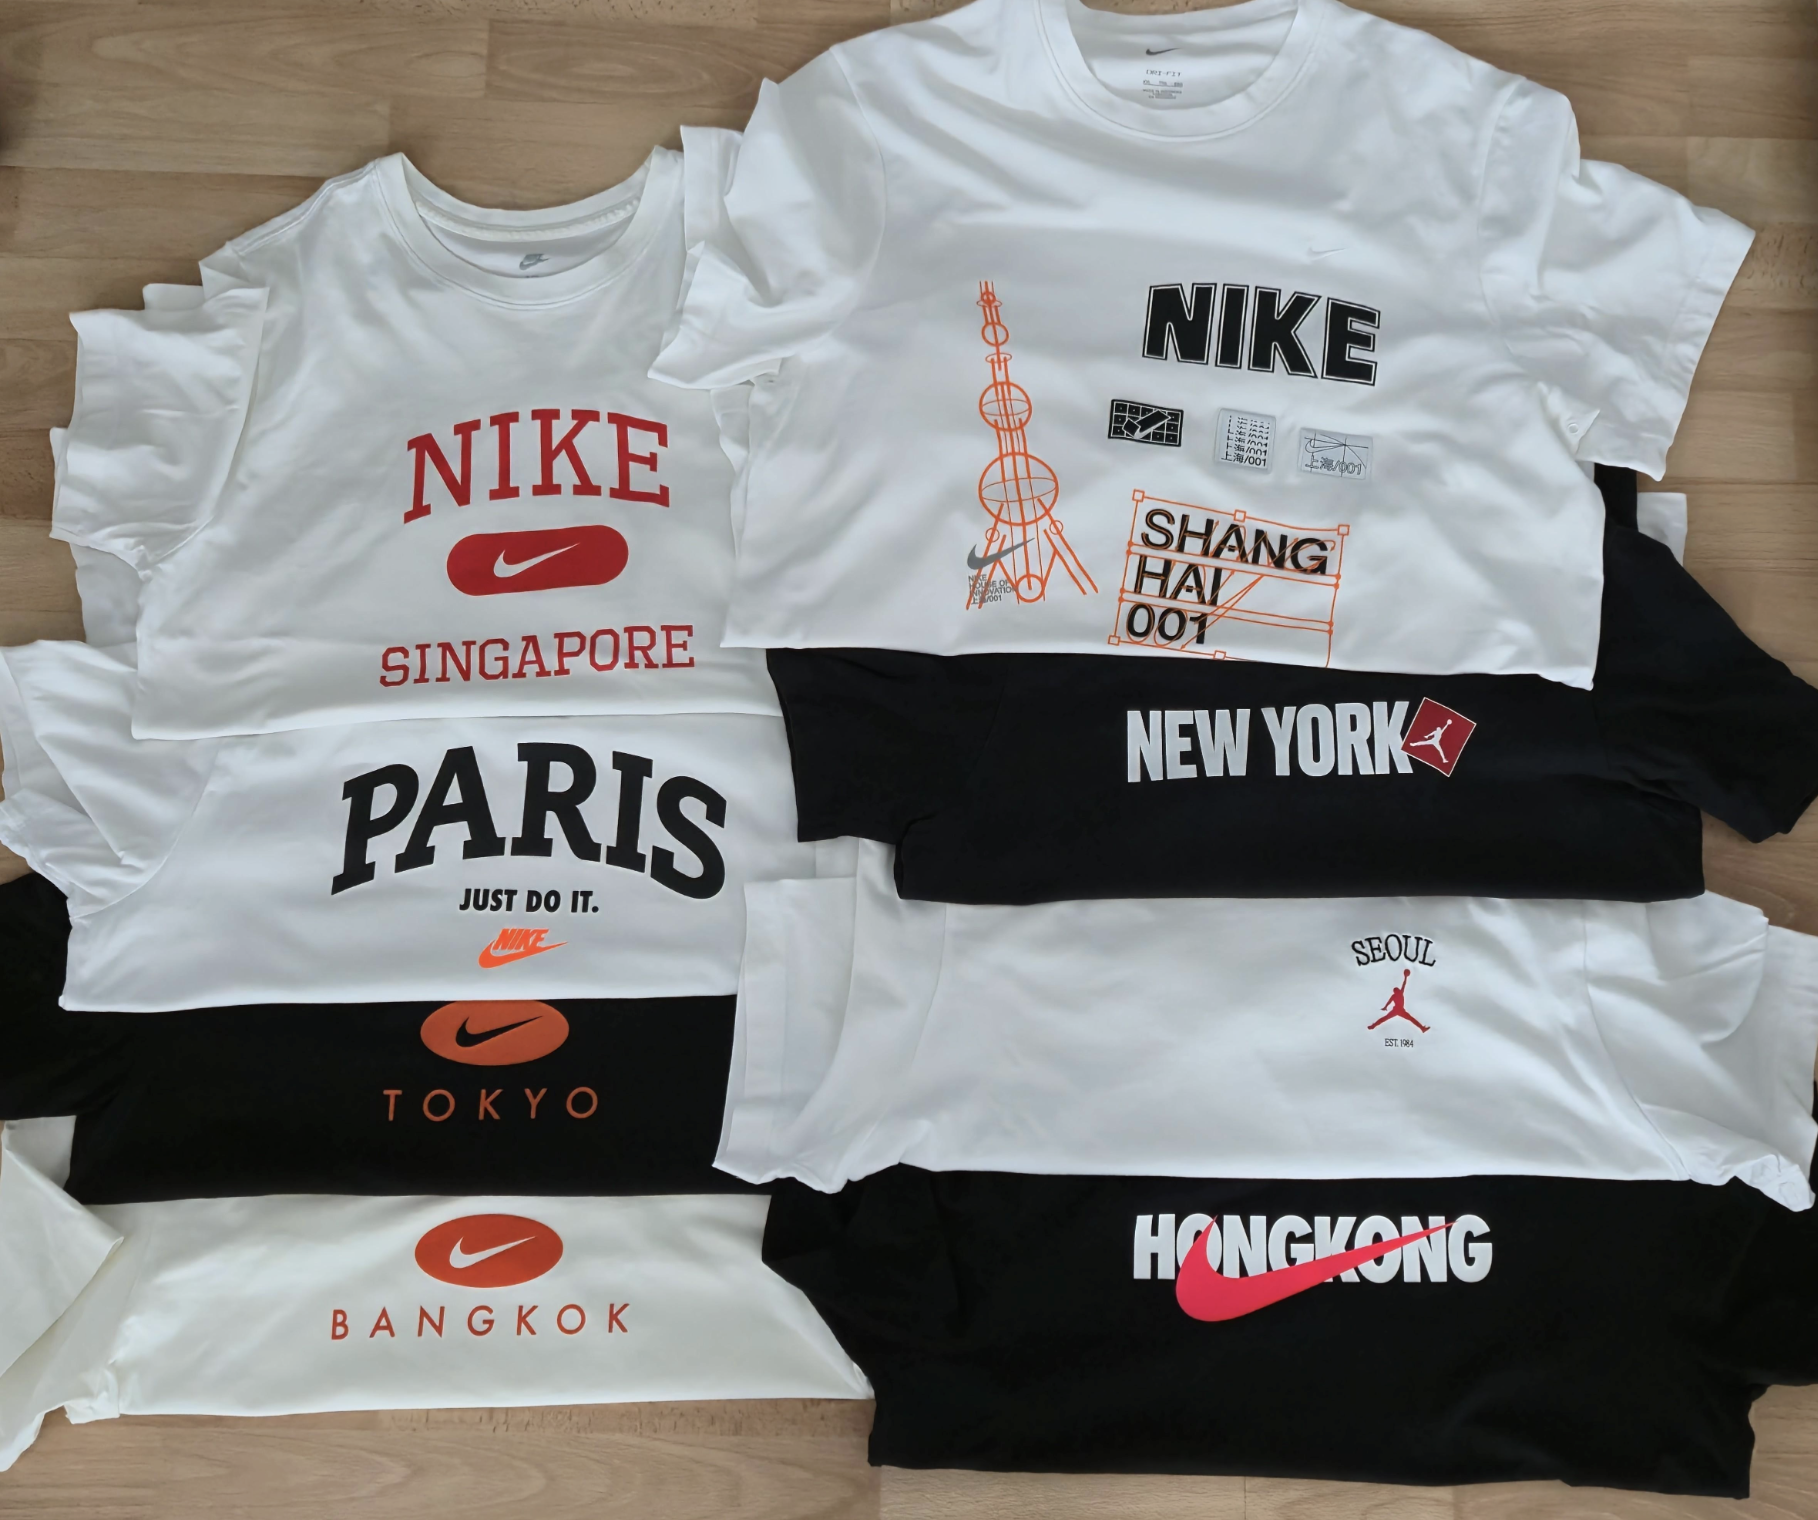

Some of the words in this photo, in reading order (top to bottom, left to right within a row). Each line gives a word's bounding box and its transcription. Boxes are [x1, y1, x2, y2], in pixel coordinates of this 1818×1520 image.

[1142, 283, 1381, 386] NIKE
[404, 408, 670, 524] NIKE
[1220, 450, 1267, 467] 上海/001
[1305, 453, 1362, 476] 上海/001
[1140, 508, 1331, 575] SHANG
[1134, 554, 1223, 607] HAI
[1126, 603, 1209, 645] 001
[379, 624, 695, 687] SINGAPORE
[1127, 709, 1251, 782] NEW
[1261, 701, 1414, 777] YORK
[331, 742, 728, 900] PARIS
[459, 888, 518, 912] JUST
[526, 889, 561, 913] DO
[571, 890, 600, 913] IT.
[492, 927, 549, 951] NIKE
[1351, 933, 1437, 967] SEOUL
[1384, 1038, 1399, 1048] EST.
[1400, 1039, 1414, 1048] 1984
[382, 1086, 598, 1122] TOKYO
[1133, 1213, 1493, 1284] HONGKONG
[331, 1303, 630, 1341] BANGKOK
